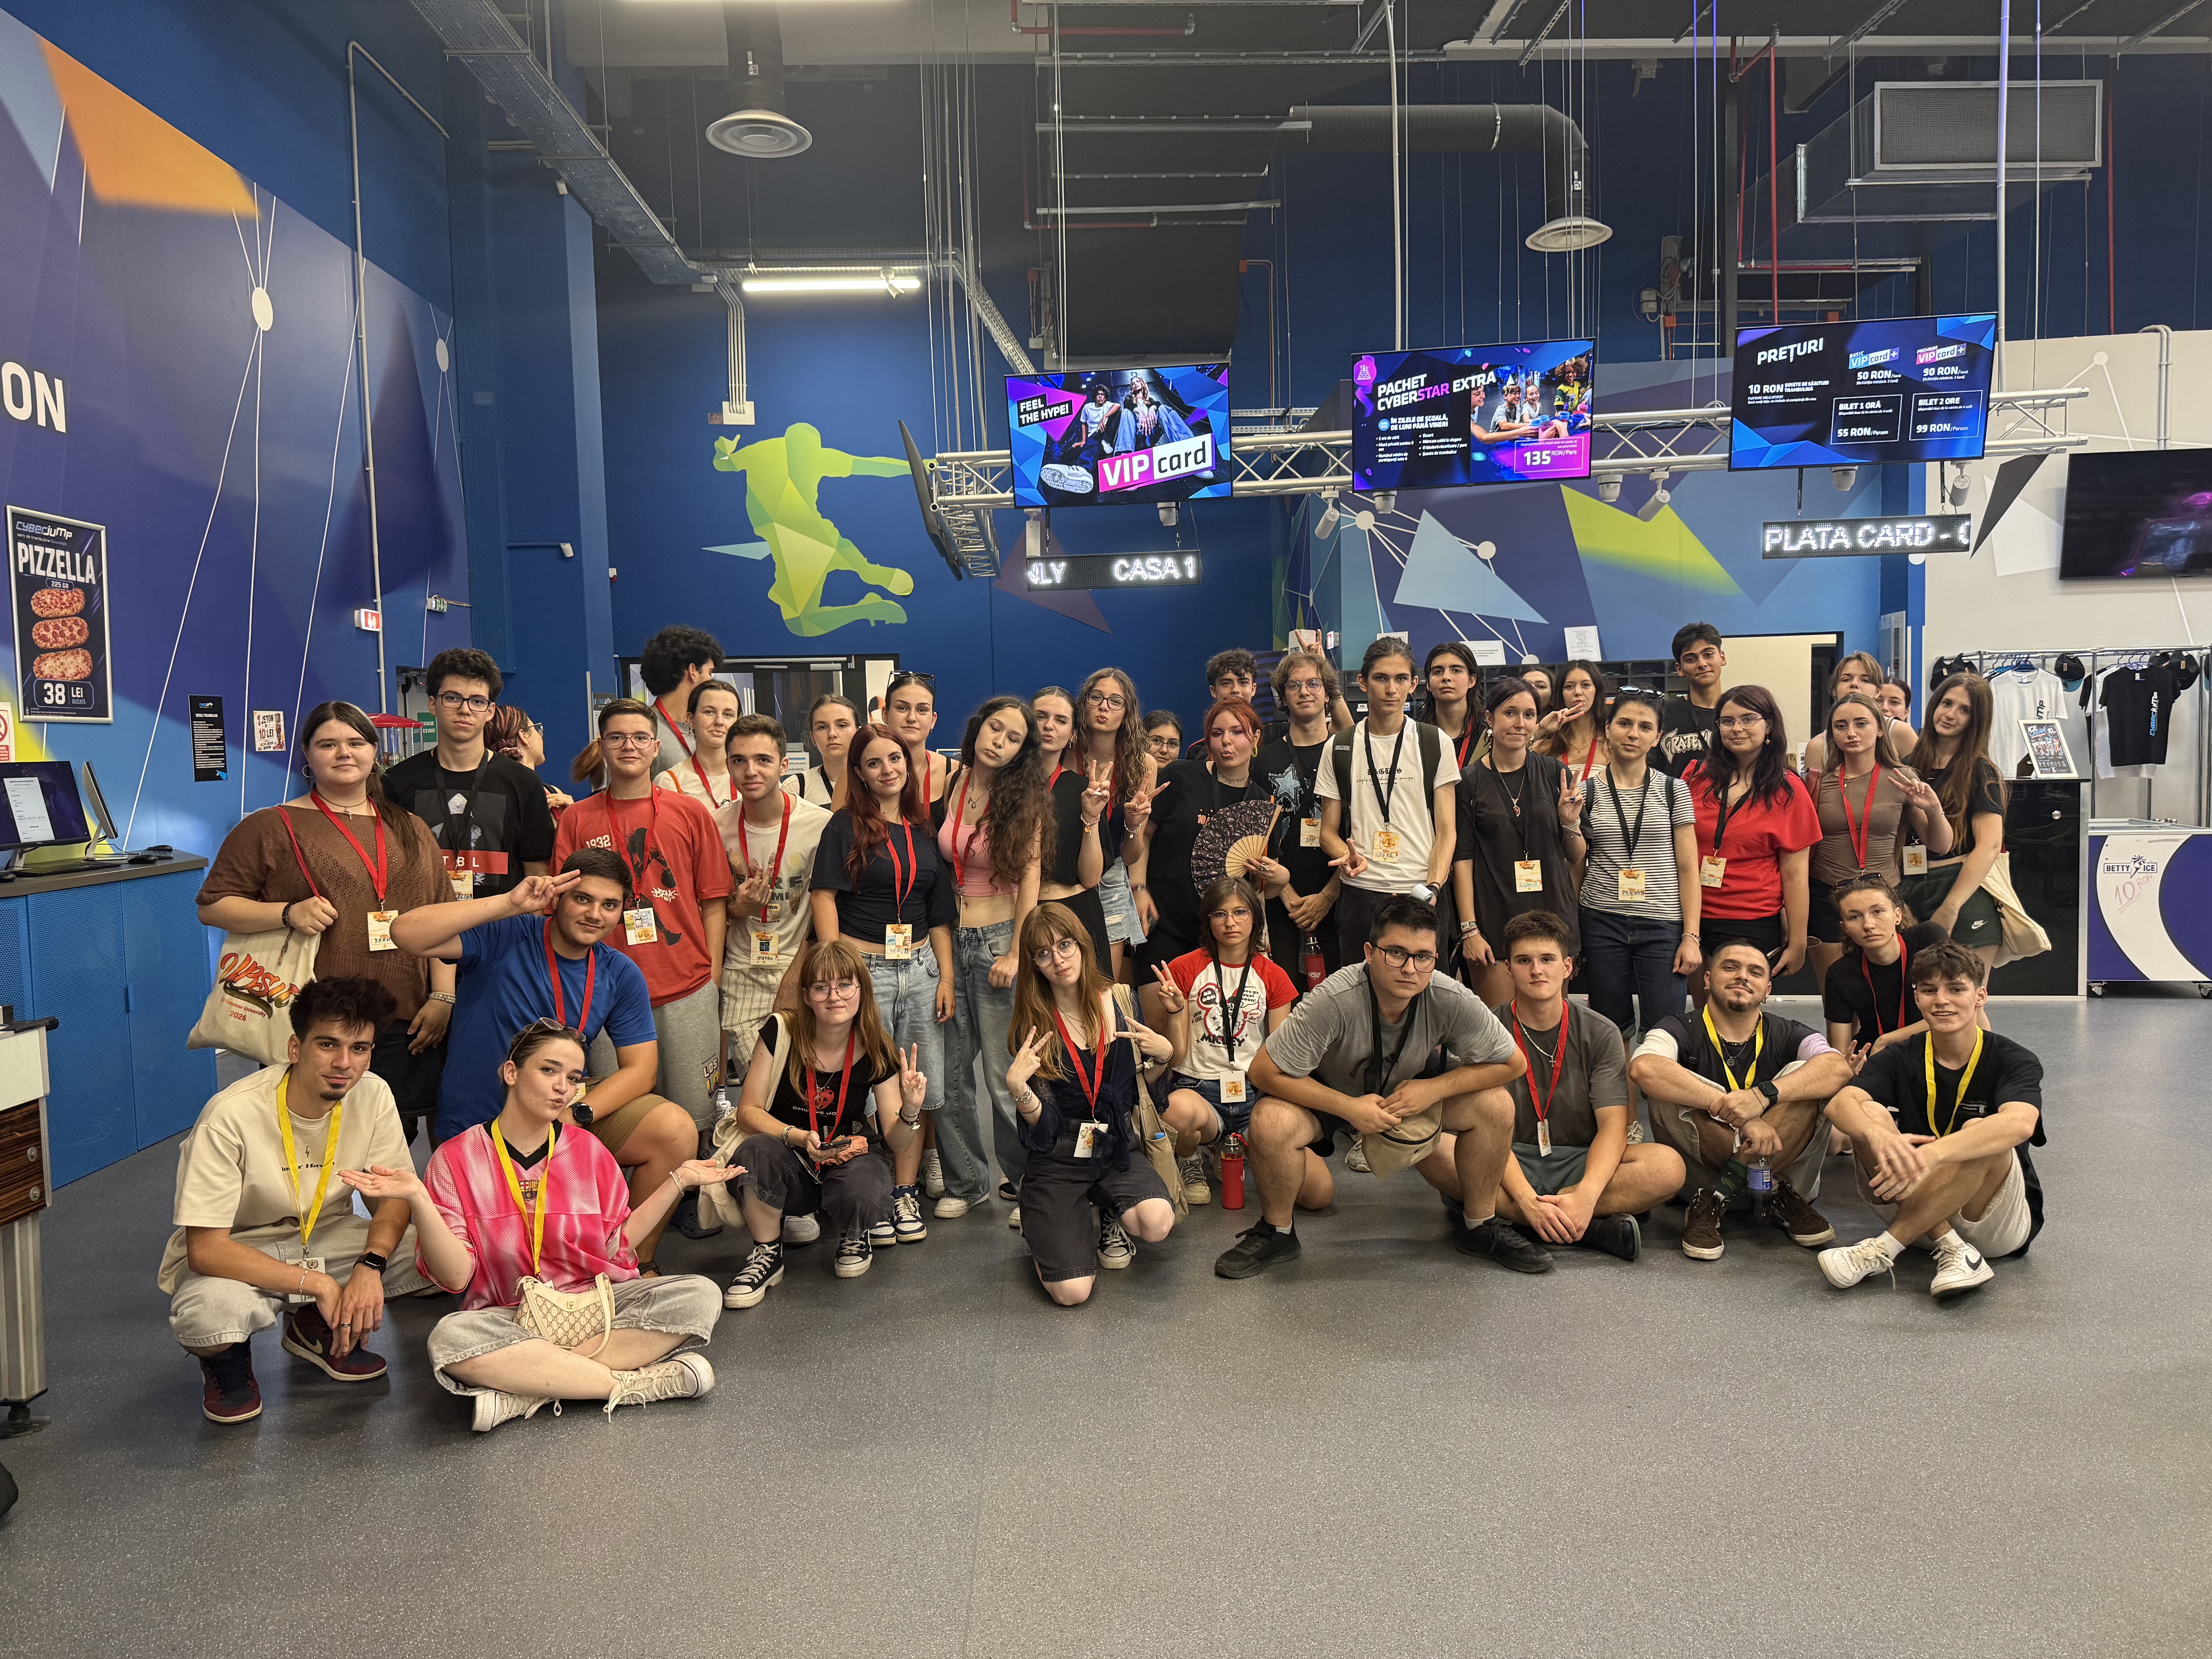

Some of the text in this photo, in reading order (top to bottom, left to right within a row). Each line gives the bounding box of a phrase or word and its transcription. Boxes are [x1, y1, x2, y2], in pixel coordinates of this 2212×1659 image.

[1757, 337, 1824, 365] PREȚURI
[1849, 350, 1864, 359] BASIC
[1851, 357, 1869, 368] VIP
[1918, 352, 1936, 363] VIP
[1857, 372, 1869, 380] 50
[1923, 368, 1935, 376] 90
[1377, 371, 1497, 411] CYBERSTAR EXTRA
[1378, 373, 1427, 398] PACHET
[1748, 384, 1784, 394] 10 RON
[2, 362, 66, 433] ON
[1020, 398, 1044, 413] FEEL
[1839, 402, 1858, 410] BILET
[1020, 404, 1069, 424] THE HYPE!
[1838, 429, 1848, 437] 55
[1916, 425, 1927, 433] 99
[1103, 441, 1206, 486] VIP card
[1523, 450, 1551, 465] 135
[1765, 525, 1850, 552] PLATA
[1858, 523, 1932, 548] CARD
[17, 542, 96, 585] PIZZELLA
[1114, 558, 1181, 582] CASA
[44, 682, 66, 705] 38
[71, 687, 83, 698] LEI
[261, 714, 274, 724] JETON
[259, 729, 266, 740] 10
[586, 835, 611, 848] 1932
[2115, 874, 2153, 905] 10 RON
[229, 1010, 247, 1021] 2026
[244, 1006, 266, 1018] University
[703, 1058, 718, 1079] LOS
[792, 1106, 824, 1114] CHOSE
